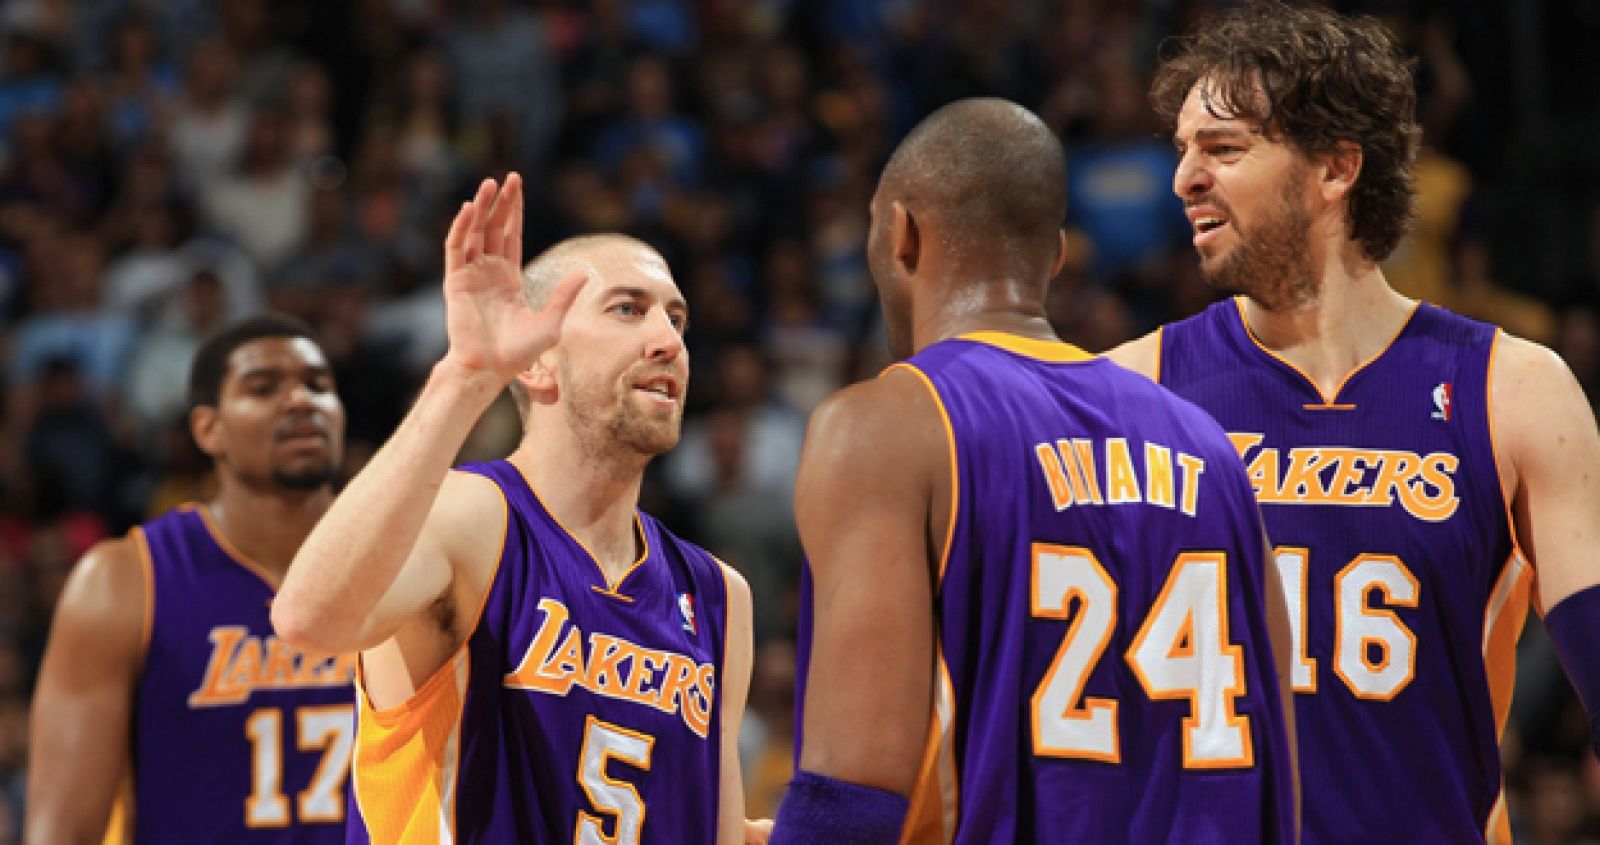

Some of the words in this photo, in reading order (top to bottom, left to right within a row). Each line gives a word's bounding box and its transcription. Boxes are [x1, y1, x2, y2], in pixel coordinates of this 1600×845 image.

[503, 597, 715, 739] LAKERS
[1031, 542, 1254, 769] 24
[245, 704, 355, 829] 17
[573, 714, 656, 845] 5
